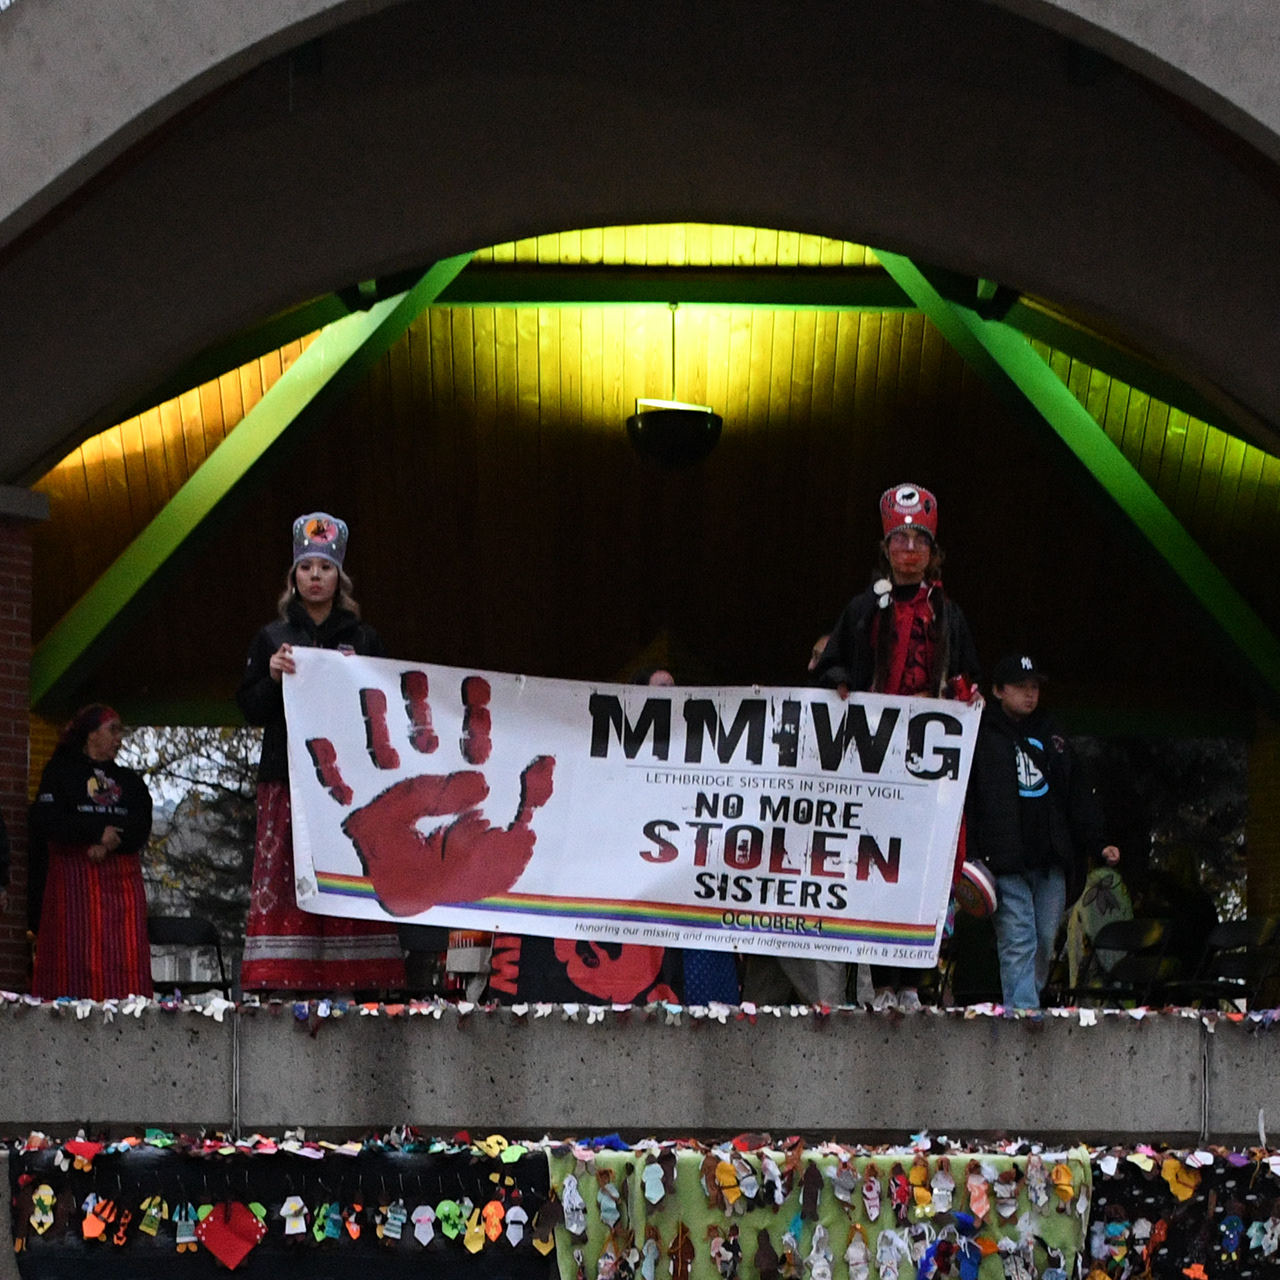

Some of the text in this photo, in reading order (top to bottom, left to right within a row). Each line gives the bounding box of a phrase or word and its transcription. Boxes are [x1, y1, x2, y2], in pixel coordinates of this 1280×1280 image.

[589, 693, 963, 781] MMIWG
[646, 772, 905, 801] LETHBRIDGE SISTERS IN SPIRIT VIGIL
[694, 792, 863, 830] NO MORE
[639, 819, 902, 884] STOLEN
[694, 872, 848, 910] SISTERS
[575, 922, 620, 935] Honoring
[622, 927, 640, 936] our
[643, 930, 680, 942] missing
[683, 932, 703, 942] and
[705, 934, 755, 946] murdered
[757, 937, 811, 951] Indigenous
[814, 943, 852, 954] women,
[856, 945, 878, 957] girls
[722, 910, 823, 935] OCTOBER 4
